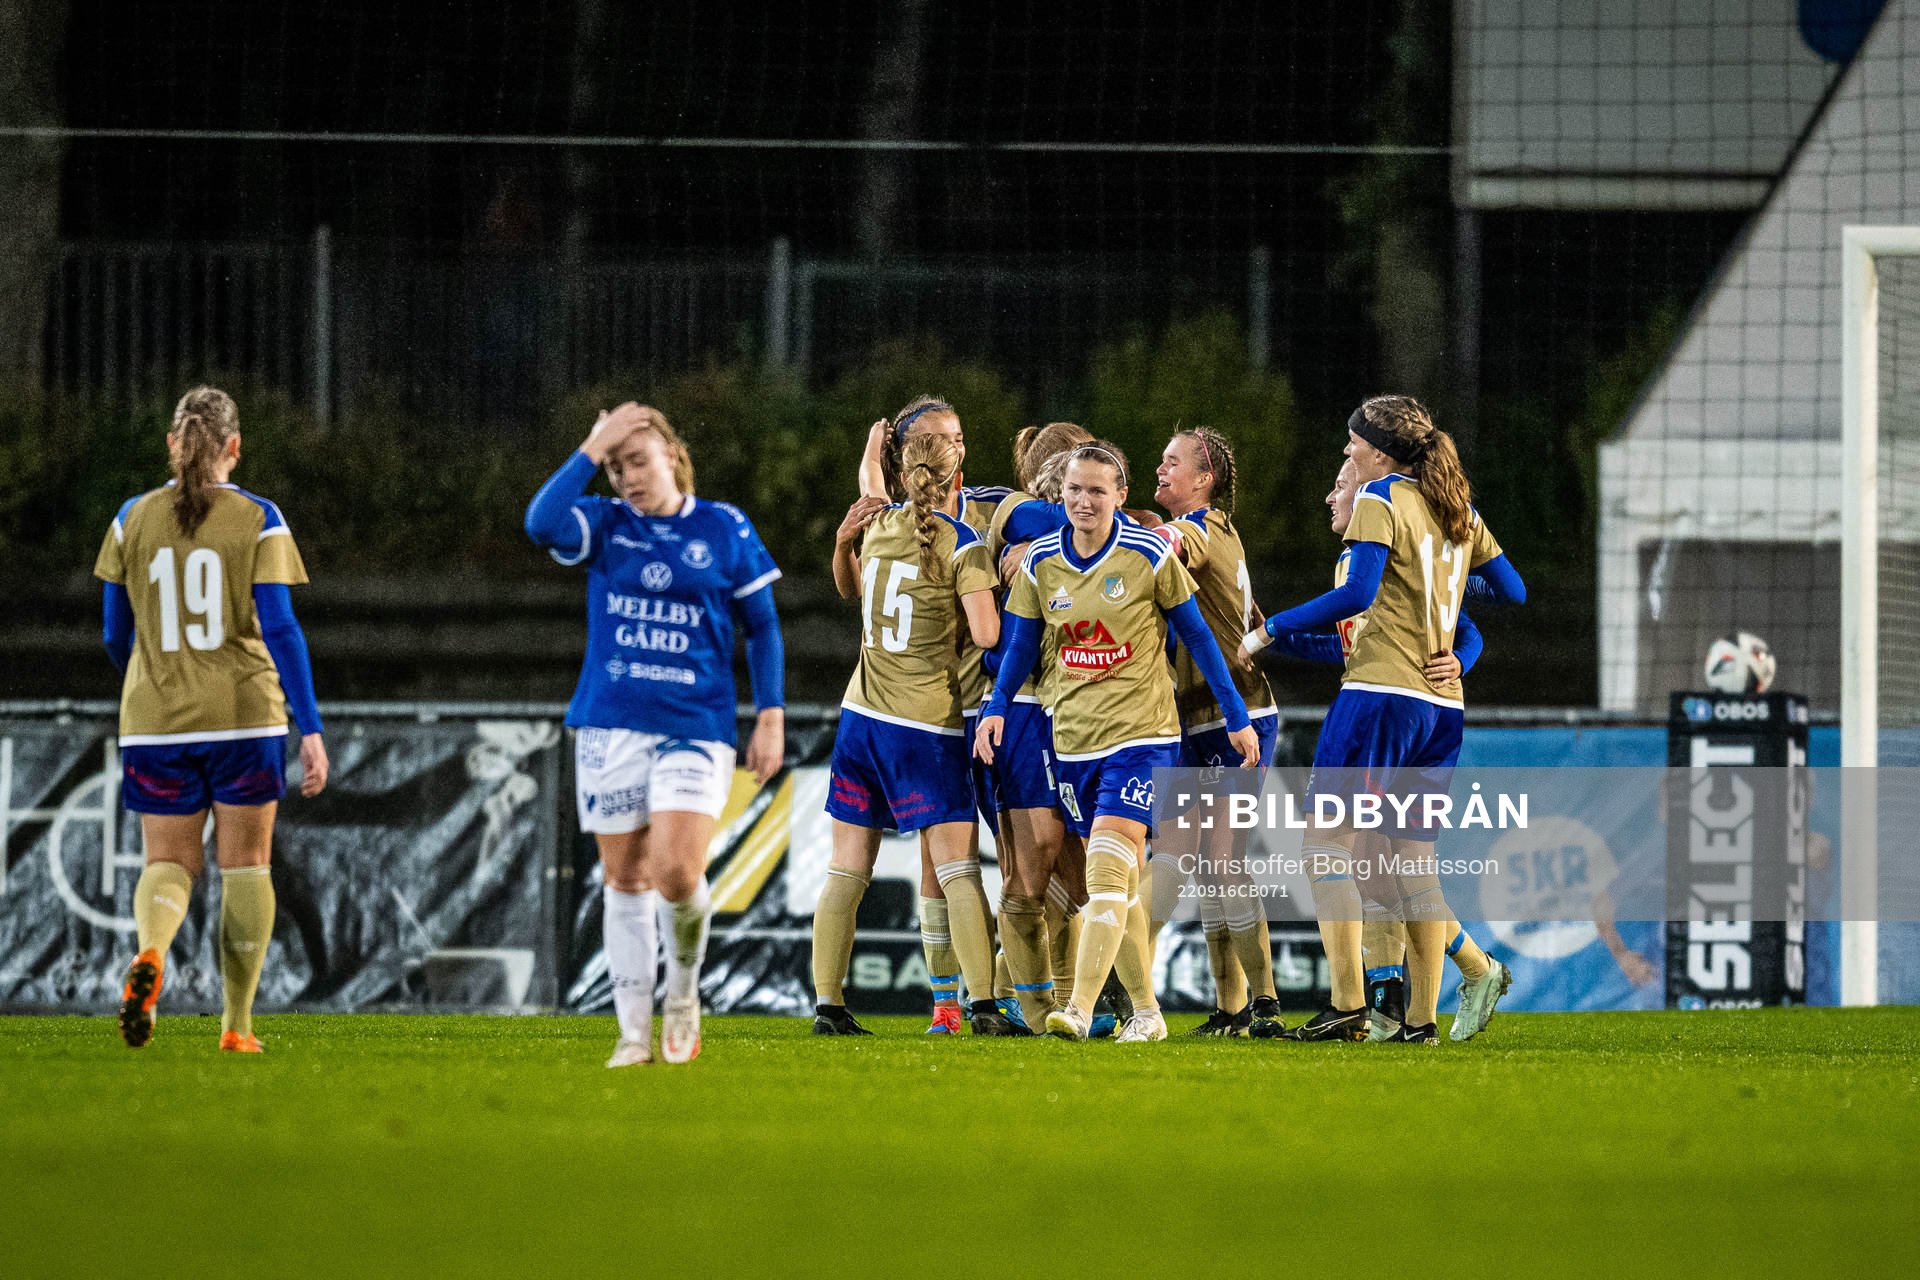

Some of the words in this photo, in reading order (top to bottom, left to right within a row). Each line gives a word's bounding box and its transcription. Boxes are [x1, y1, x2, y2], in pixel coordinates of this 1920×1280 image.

[149, 547, 224, 652] 19
[607, 591, 705, 628] MELLBY
[863, 556, 919, 652] 15
[1420, 533, 1463, 633] 13
[615, 621, 690, 654] GÅRD
[1062, 618, 1117, 646] ICA
[1064, 645, 1128, 665] KVANTUM
[1687, 738, 1755, 990] SELECT
